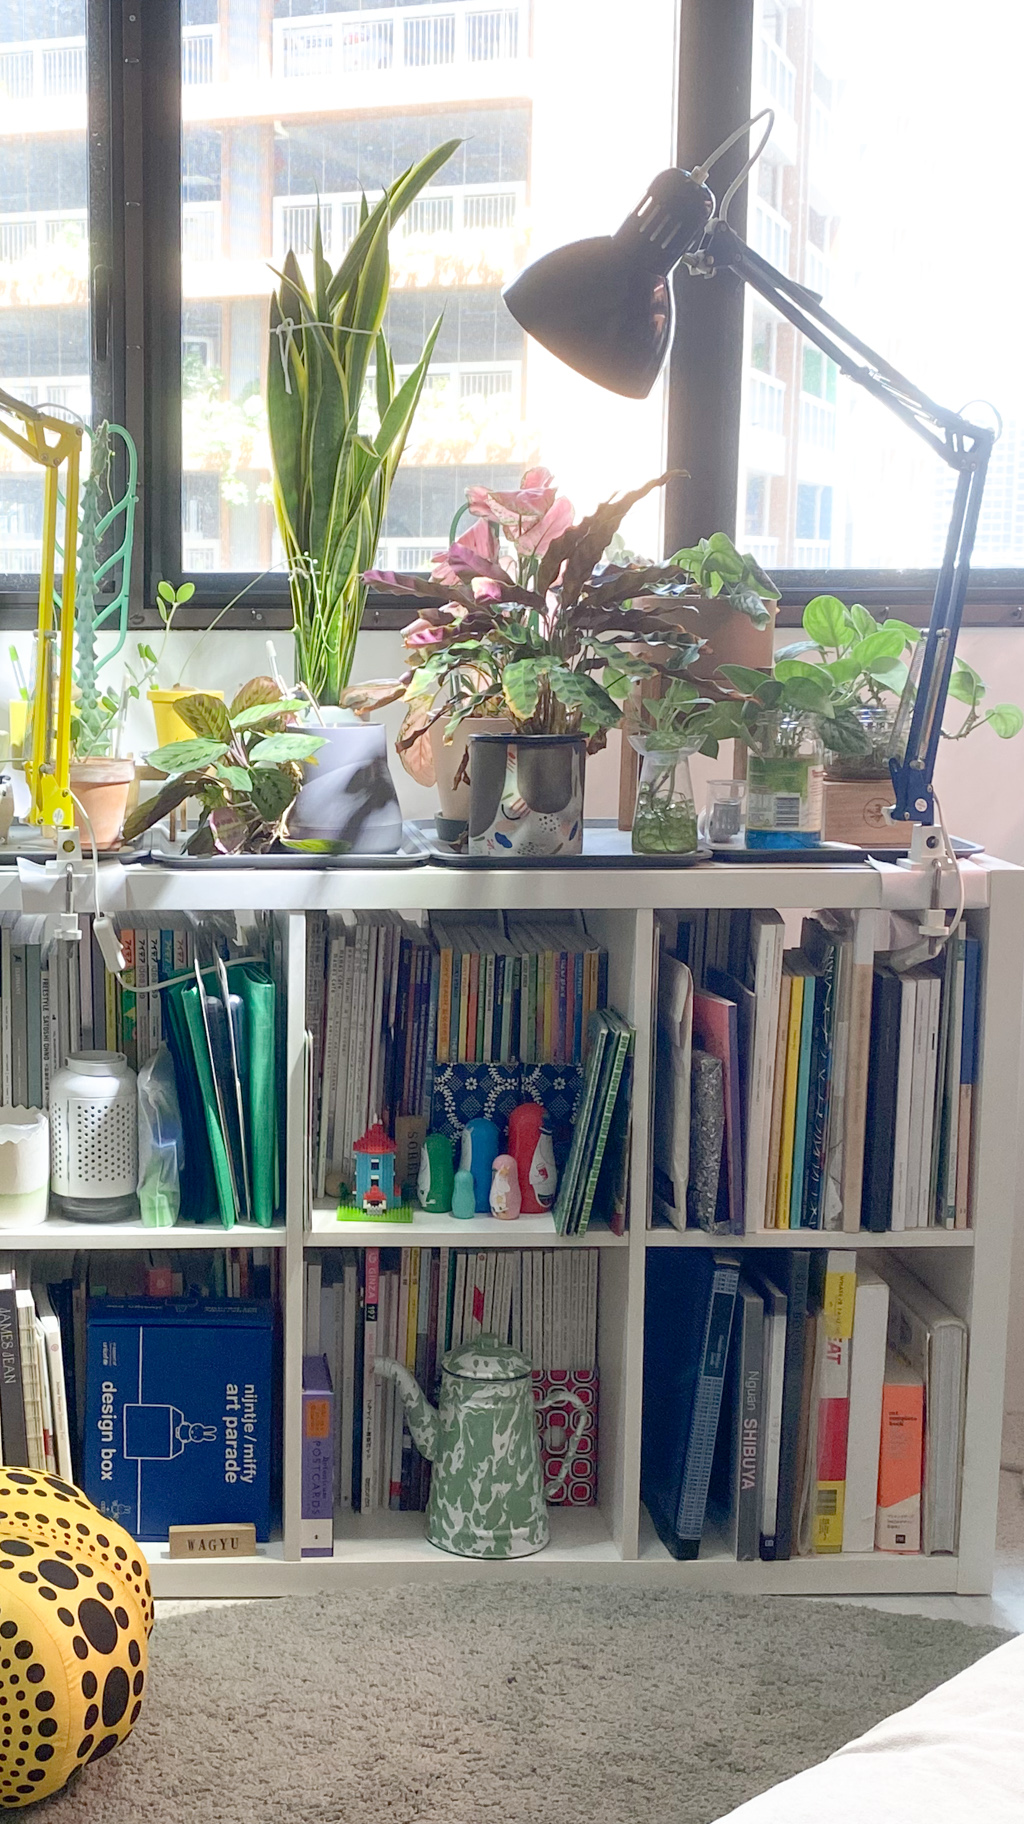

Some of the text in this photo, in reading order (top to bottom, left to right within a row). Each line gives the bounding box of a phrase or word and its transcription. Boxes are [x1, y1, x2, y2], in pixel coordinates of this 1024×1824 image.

[42, 978, 50, 1011] FREESTYLE
[43, 1043, 51, 1061] OHNO
[367, 1267, 378, 1320] GINZA 197
[2, 1351, 17, 1384] JEAN
[98, 1381, 118, 1481] design box
[222, 1383, 241, 1484] art parade
[239, 1384, 257, 1484] nijntje / miffy
[742, 1370, 760, 1490] Nguan SHIBUYA
[311, 1440, 321, 1515] POSTCARDS
[187, 1537, 239, 1552] WAGYU
